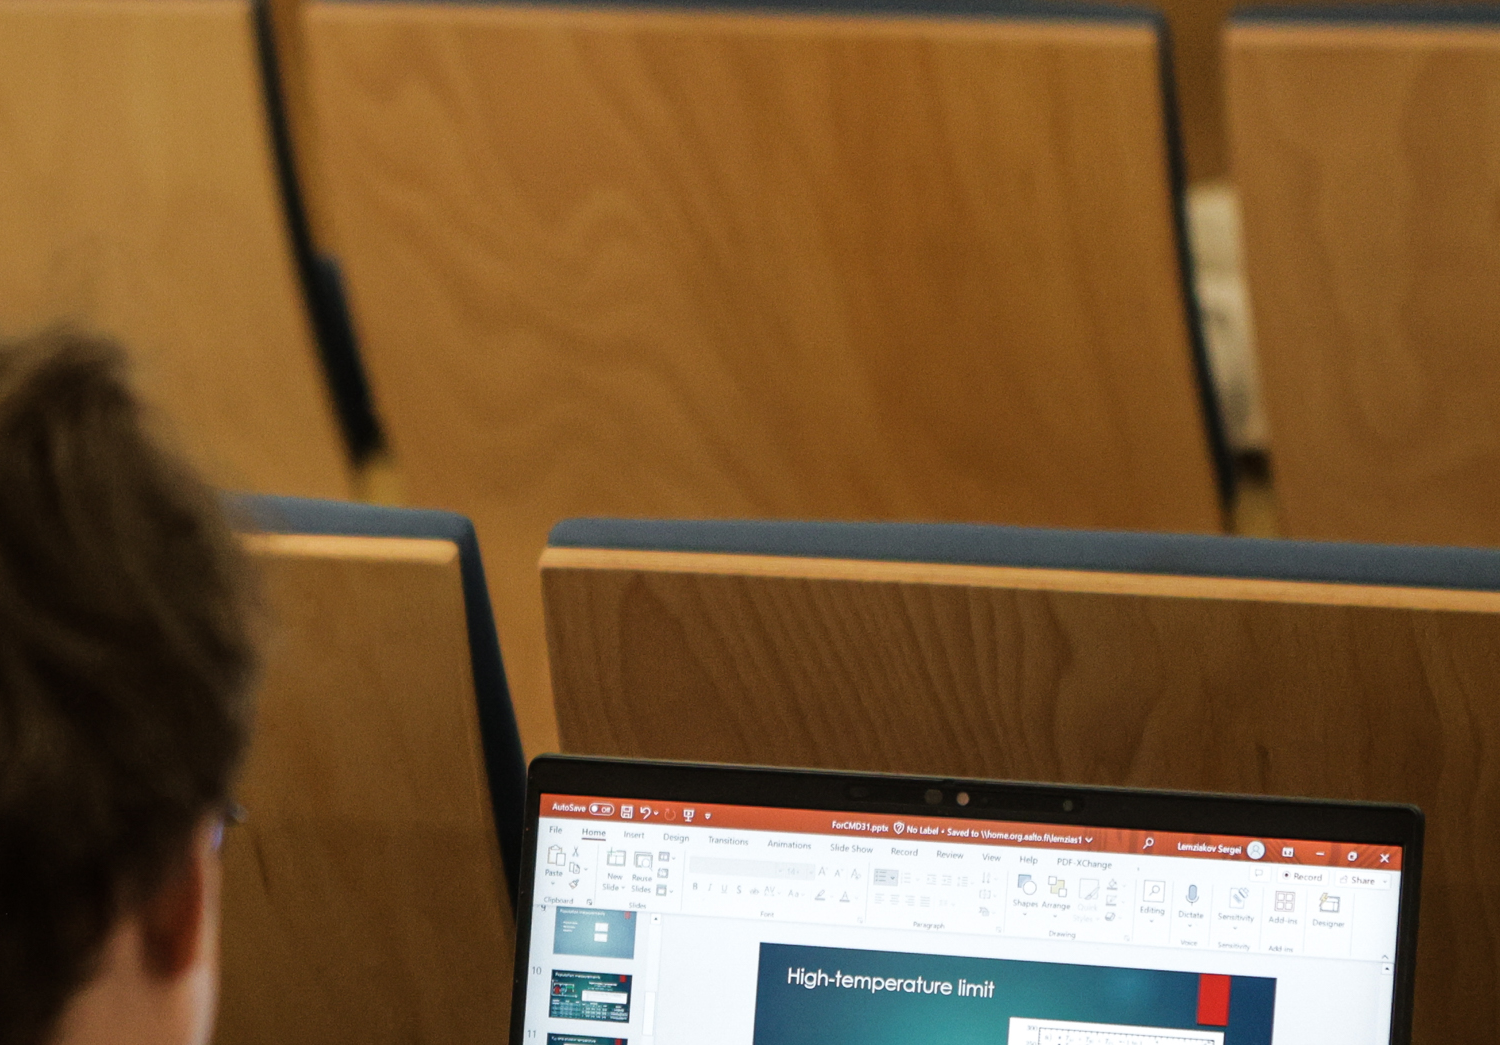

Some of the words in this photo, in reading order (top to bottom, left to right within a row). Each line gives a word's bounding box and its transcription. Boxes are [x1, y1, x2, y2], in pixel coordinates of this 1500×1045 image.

[552, 803, 586, 813] AutoSave
[550, 826, 562, 835] File
[582, 828, 606, 837] Home
[832, 821, 889, 833] ForCMD31.pptx
[906, 826, 917, 834] No
[919, 826, 939, 836] Label
[947, 828, 969, 838] Saved
[624, 830, 645, 840] Insert
[664, 833, 690, 843] Design
[708, 836, 749, 846] Transitions
[768, 840, 812, 850] Animations
[830, 843, 850, 853] Slide
[851, 845, 873, 854] Show
[891, 847, 919, 857] Record
[1218, 845, 1242, 855] Sergei
[936, 850, 964, 860] Review
[982, 853, 1001, 862] View
[1020, 856, 1038, 866] Help
[1057, 858, 1112, 870] PDF-XChange
[545, 870, 563, 878] Paste
[608, 873, 623, 881] New
[632, 874, 653, 883] Reuse
[1294, 872, 1323, 882] Record
[1352, 876, 1375, 885] Share
[632, 885, 652, 894] Slides
[544, 897, 574, 906] Clipboard
[1013, 900, 1039, 909] Shapes
[1042, 902, 1071, 911] Arrange
[1140, 906, 1166, 916] Editing
[1178, 910, 1204, 920] Dictate
[1218, 913, 1255, 924] Sensitivity
[1268, 916, 1298, 926] Add-ins
[1312, 919, 1345, 929] Designer
[1049, 930, 1076, 940] Drawing
[788, 967, 953, 995] High-temperature
[958, 979, 995, 999] limit
